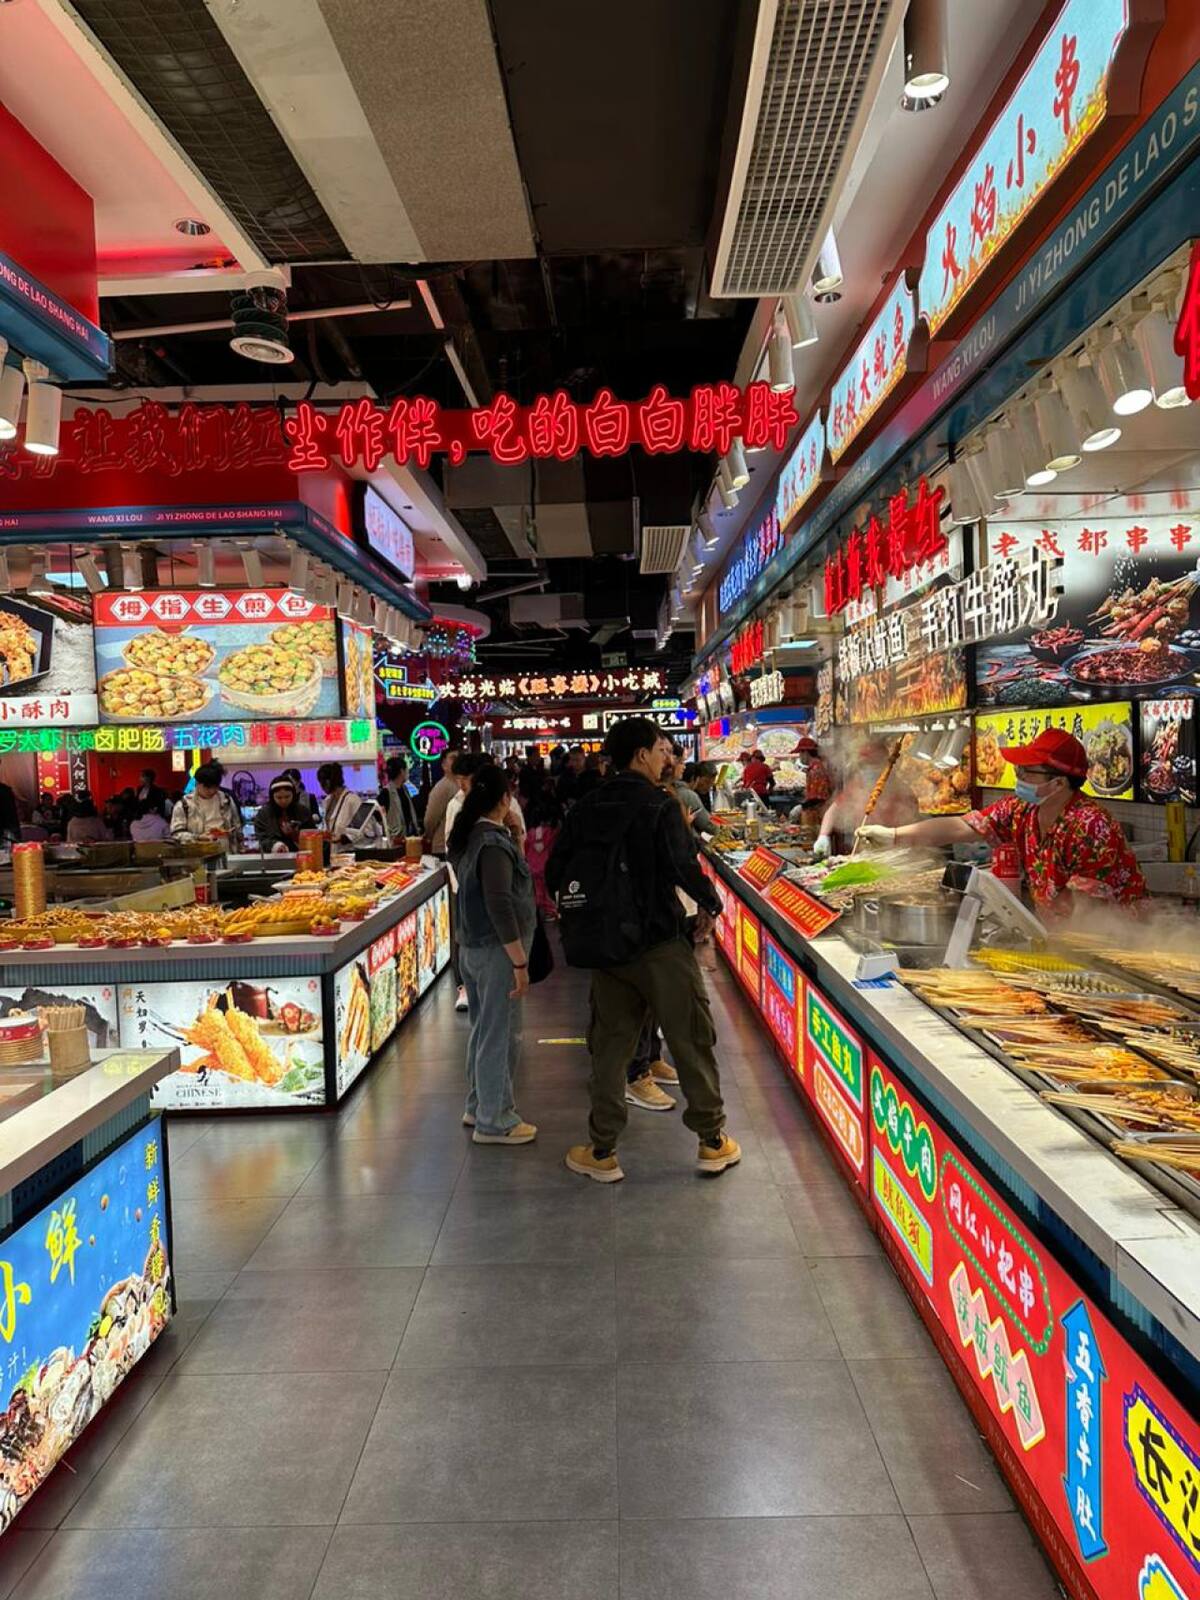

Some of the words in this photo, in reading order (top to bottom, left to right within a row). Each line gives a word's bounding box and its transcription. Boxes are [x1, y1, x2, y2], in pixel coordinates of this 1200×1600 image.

[933, 357, 961, 401] WANG
[962, 343, 972, 369] XI
[973, 315, 996, 357] LOU
[1015, 283, 1027, 312] JI
[1029, 266, 1043, 291] YI
[1043, 206, 1100, 280] ZHONG
[1104, 174, 1129, 212] DE
[1133, 111, 1177, 176] LAO
[18, 275, 31, 297] DE
[30, 286, 48, 311] LAO
[48, 300, 76, 333] SHANG
[87, 515, 116, 524] WANG
[116, 515, 126, 523] XI
[126, 514, 143, 523] LOU
[174, 512, 205, 521] ZHONG
[205, 511, 217, 520] DE
[218, 511, 236, 519] LAO
[236, 510, 266, 519] SHANG
[267, 510, 283, 518] HAI
[992, 523, 1193, 558] 老成都串串
[94, 727, 166, 752] 卤肥肠
[173, 724, 246, 751] 五花肉
